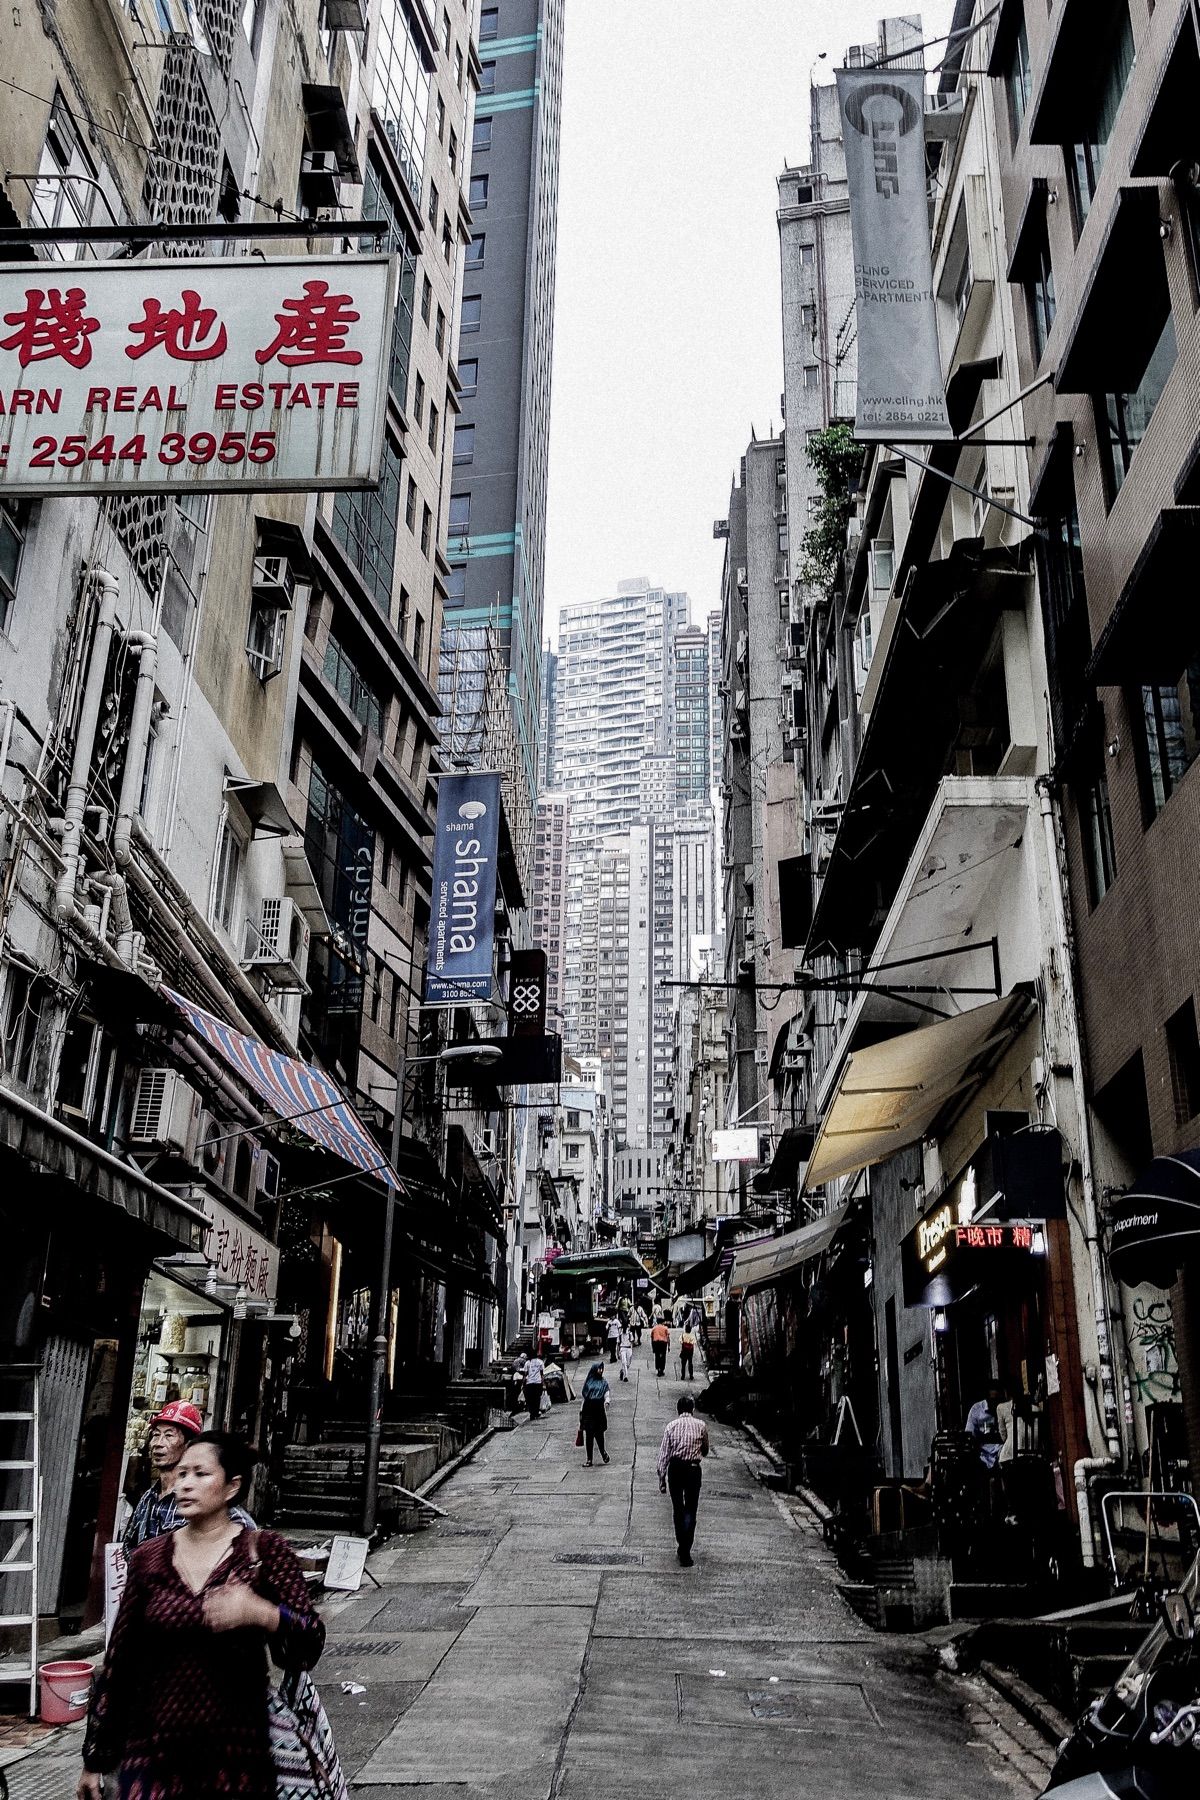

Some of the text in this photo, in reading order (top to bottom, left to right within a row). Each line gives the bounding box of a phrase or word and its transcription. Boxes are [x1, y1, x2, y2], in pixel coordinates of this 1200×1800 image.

[854, 264, 890, 276] CLING
[855, 278, 915, 290] SERVICED
[86, 386, 187, 412] REAL
[215, 382, 360, 410] ESTATE
[863, 395, 943, 408] www.cling.hk
[863, 411, 945, 422] tel: 2854 0221
[29, 434, 147, 467] 2544
[158, 431, 276, 465] 3955
[445, 822, 474, 832] shama
[450, 838, 488, 954] shama
[435, 880, 448, 971] serviced apartments
[442, 990, 458, 998] 3100
